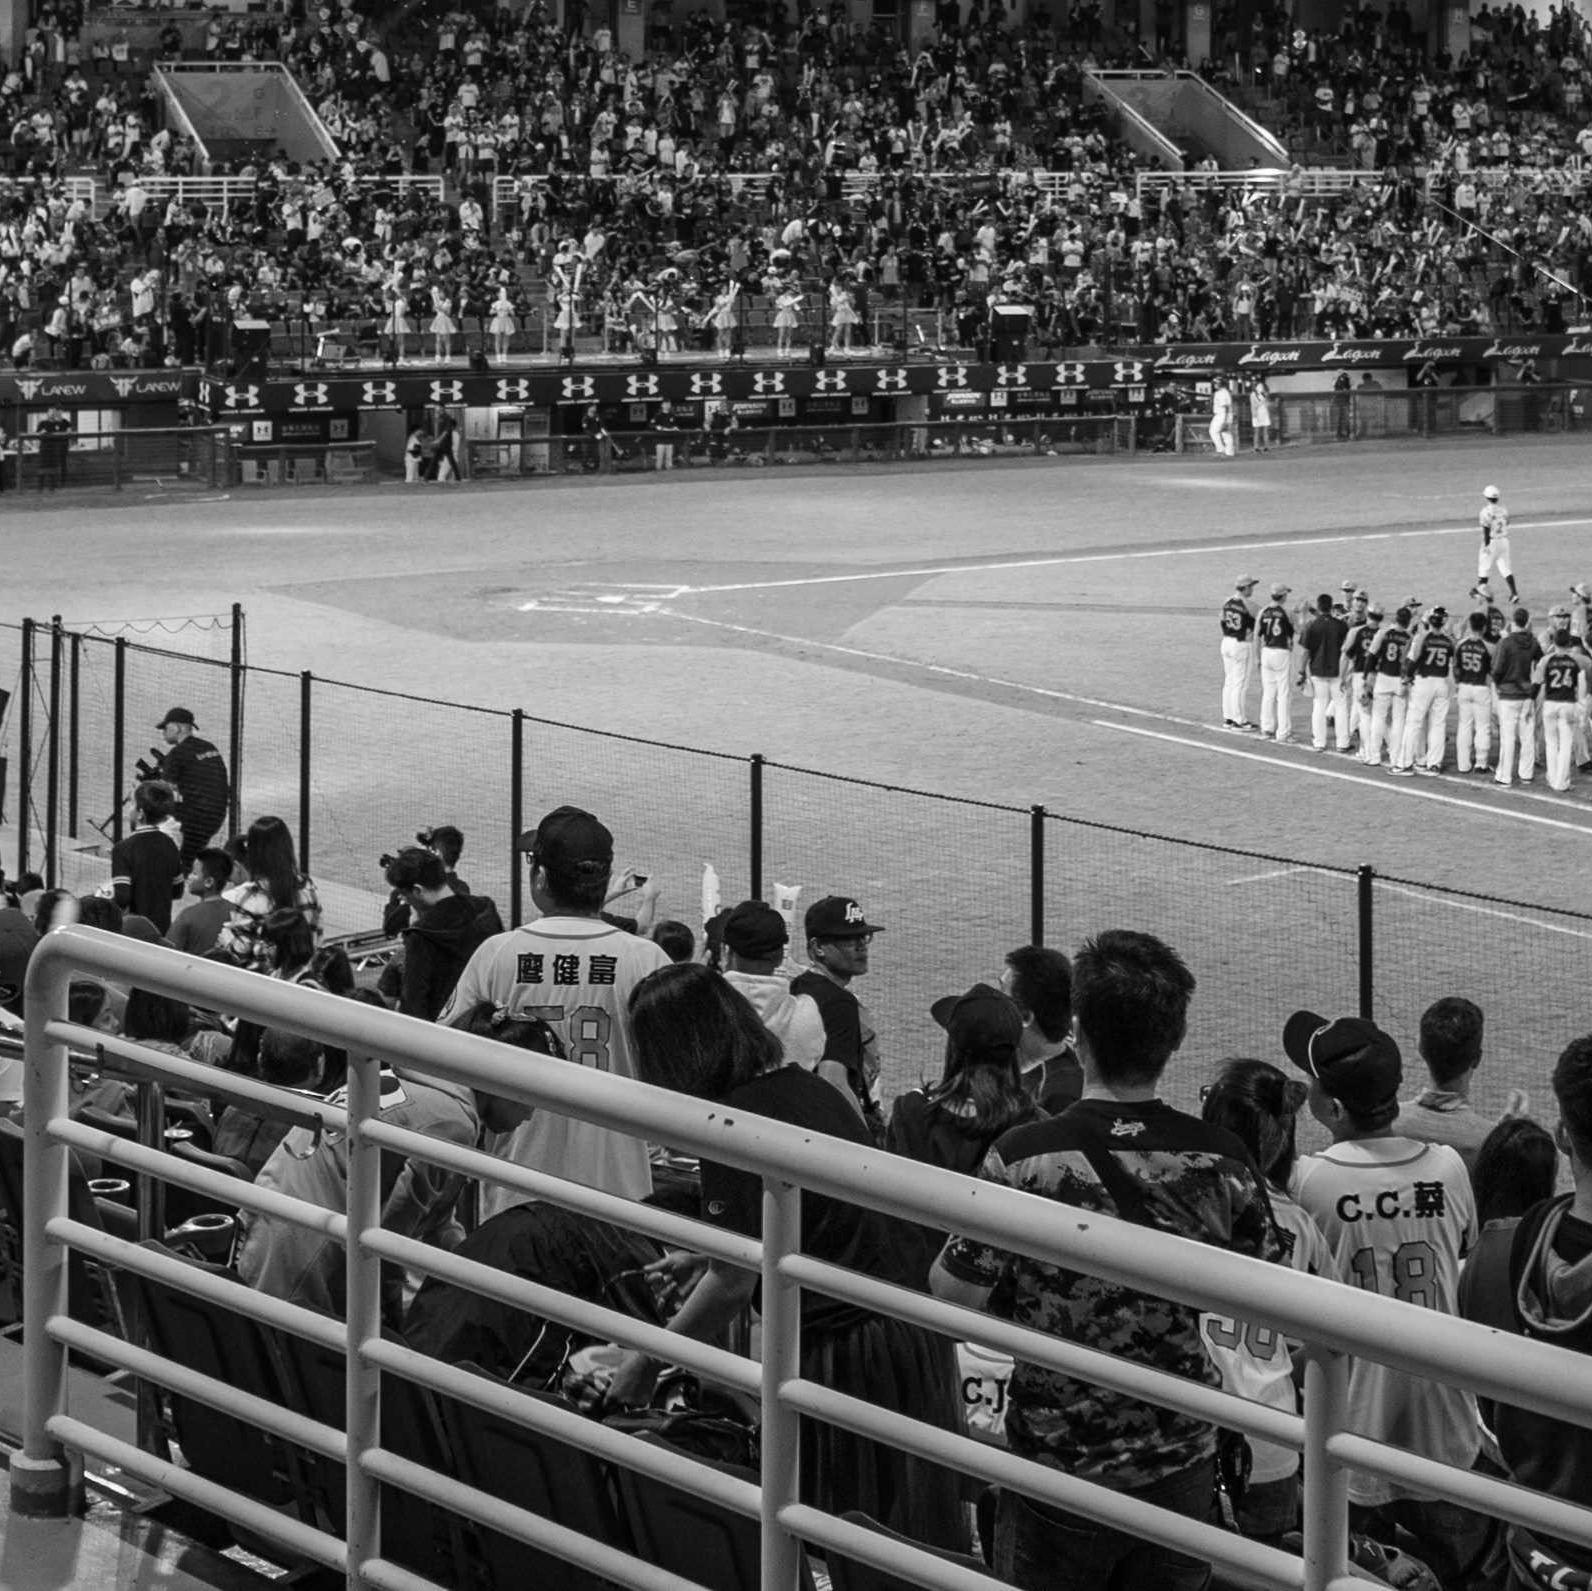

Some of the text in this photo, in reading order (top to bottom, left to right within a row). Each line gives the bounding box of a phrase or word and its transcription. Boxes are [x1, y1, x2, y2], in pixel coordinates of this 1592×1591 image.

[41, 384, 88, 397] LANEW
[136, 381, 183, 394] LANEW
[1225, 610, 1242, 631] 53
[1262, 617, 1282, 637] 76
[1426, 647, 1448, 667] 75
[1462, 651, 1483, 673] 55
[515, 952, 619, 986] 廖健富
